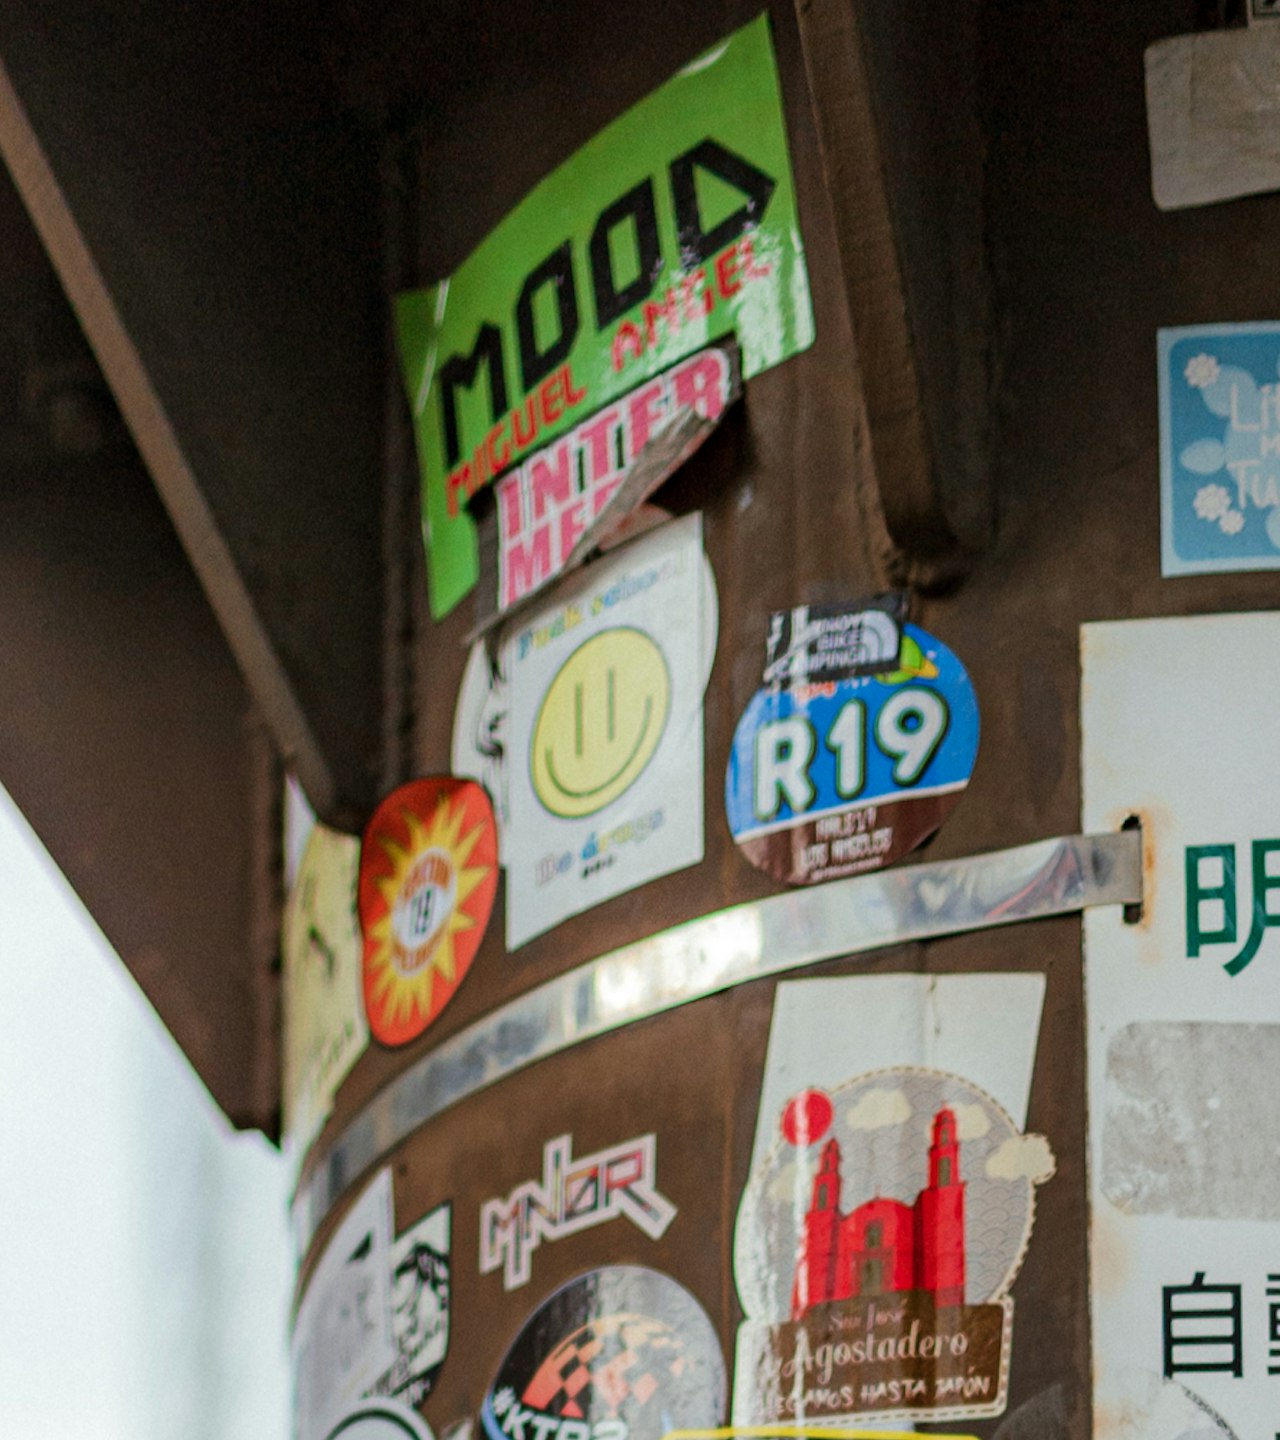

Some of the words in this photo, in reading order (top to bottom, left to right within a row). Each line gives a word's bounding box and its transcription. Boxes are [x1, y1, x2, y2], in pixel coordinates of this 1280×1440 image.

[439, 137, 777, 468] MOOD
[446, 364, 587, 519] MIGUEL
[754, 685, 950, 822] R19
[781, 1319, 969, 1385] Agostadero
[860, 1378, 928, 1403] HASTA
